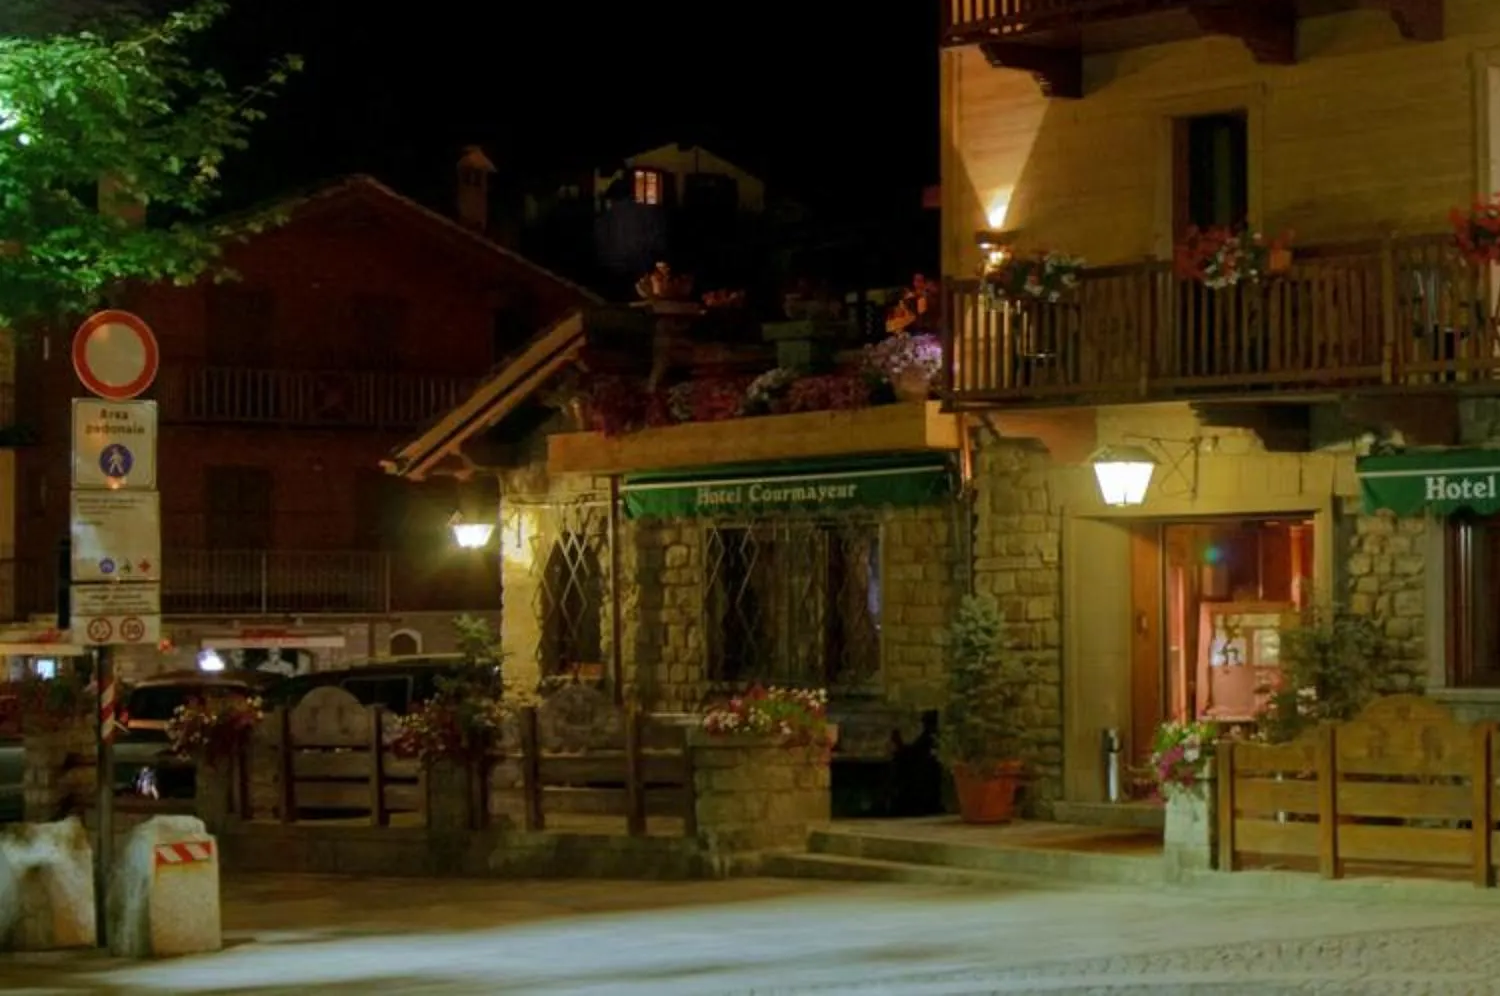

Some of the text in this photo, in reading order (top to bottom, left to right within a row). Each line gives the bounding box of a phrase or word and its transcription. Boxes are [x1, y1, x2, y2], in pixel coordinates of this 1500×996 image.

[697, 483, 858, 505] Hotel Courmayeur
[1425, 475, 1497, 500] Hotel
